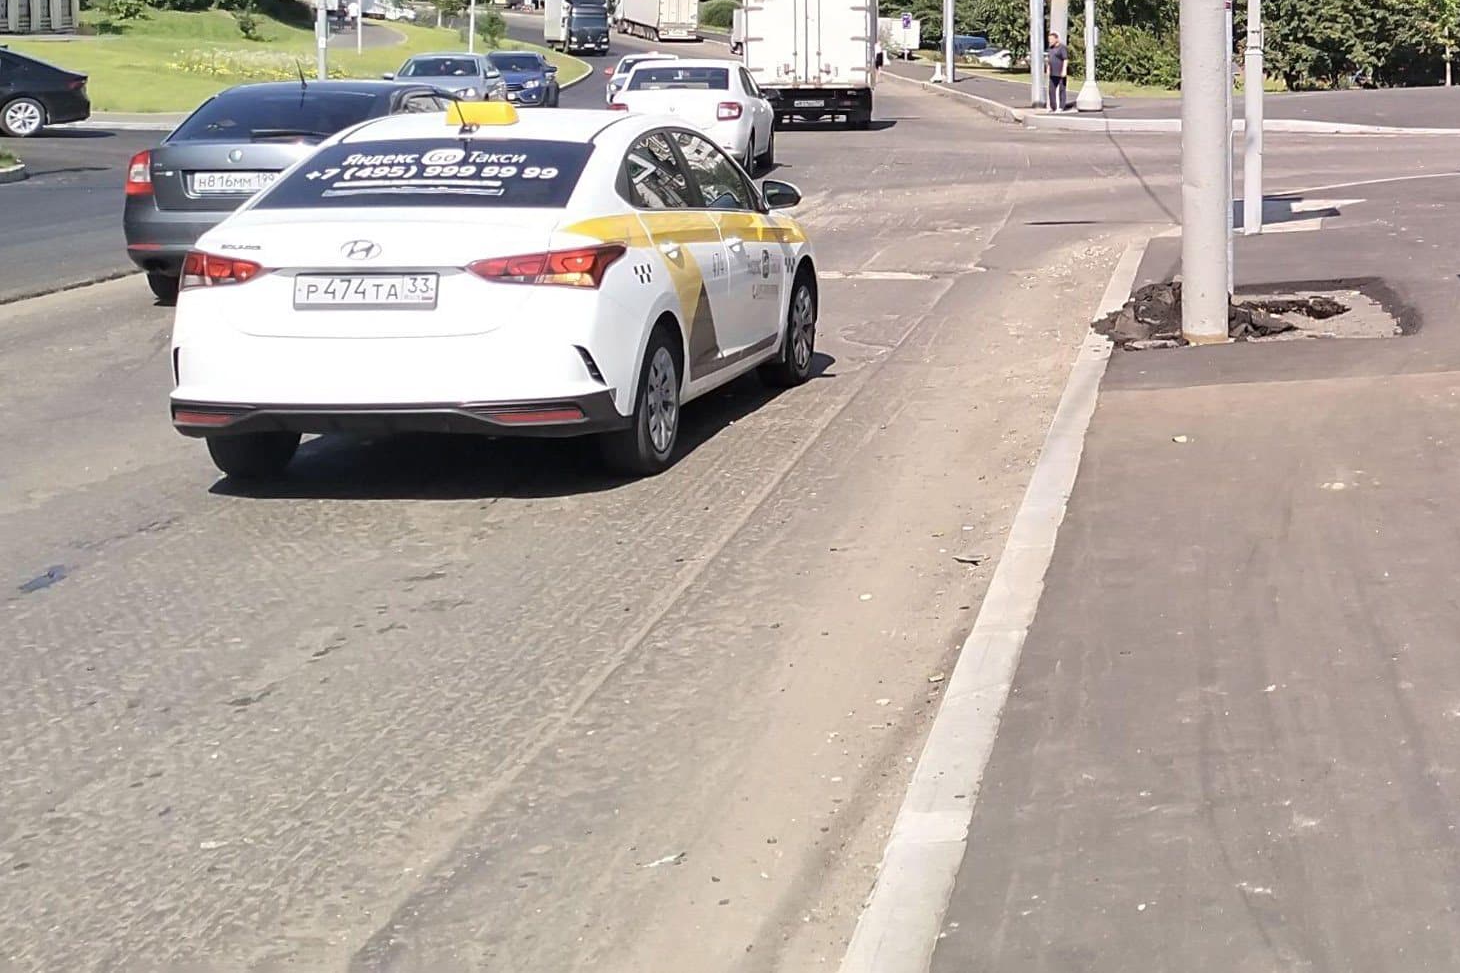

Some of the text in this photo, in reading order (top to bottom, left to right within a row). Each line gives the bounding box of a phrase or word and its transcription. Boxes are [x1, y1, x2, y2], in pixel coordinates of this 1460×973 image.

[342, 153, 418, 166] Яндекс
[469, 151, 527, 163] Такси
[306, 165, 558, 180] +7 (495) 999 99 99
